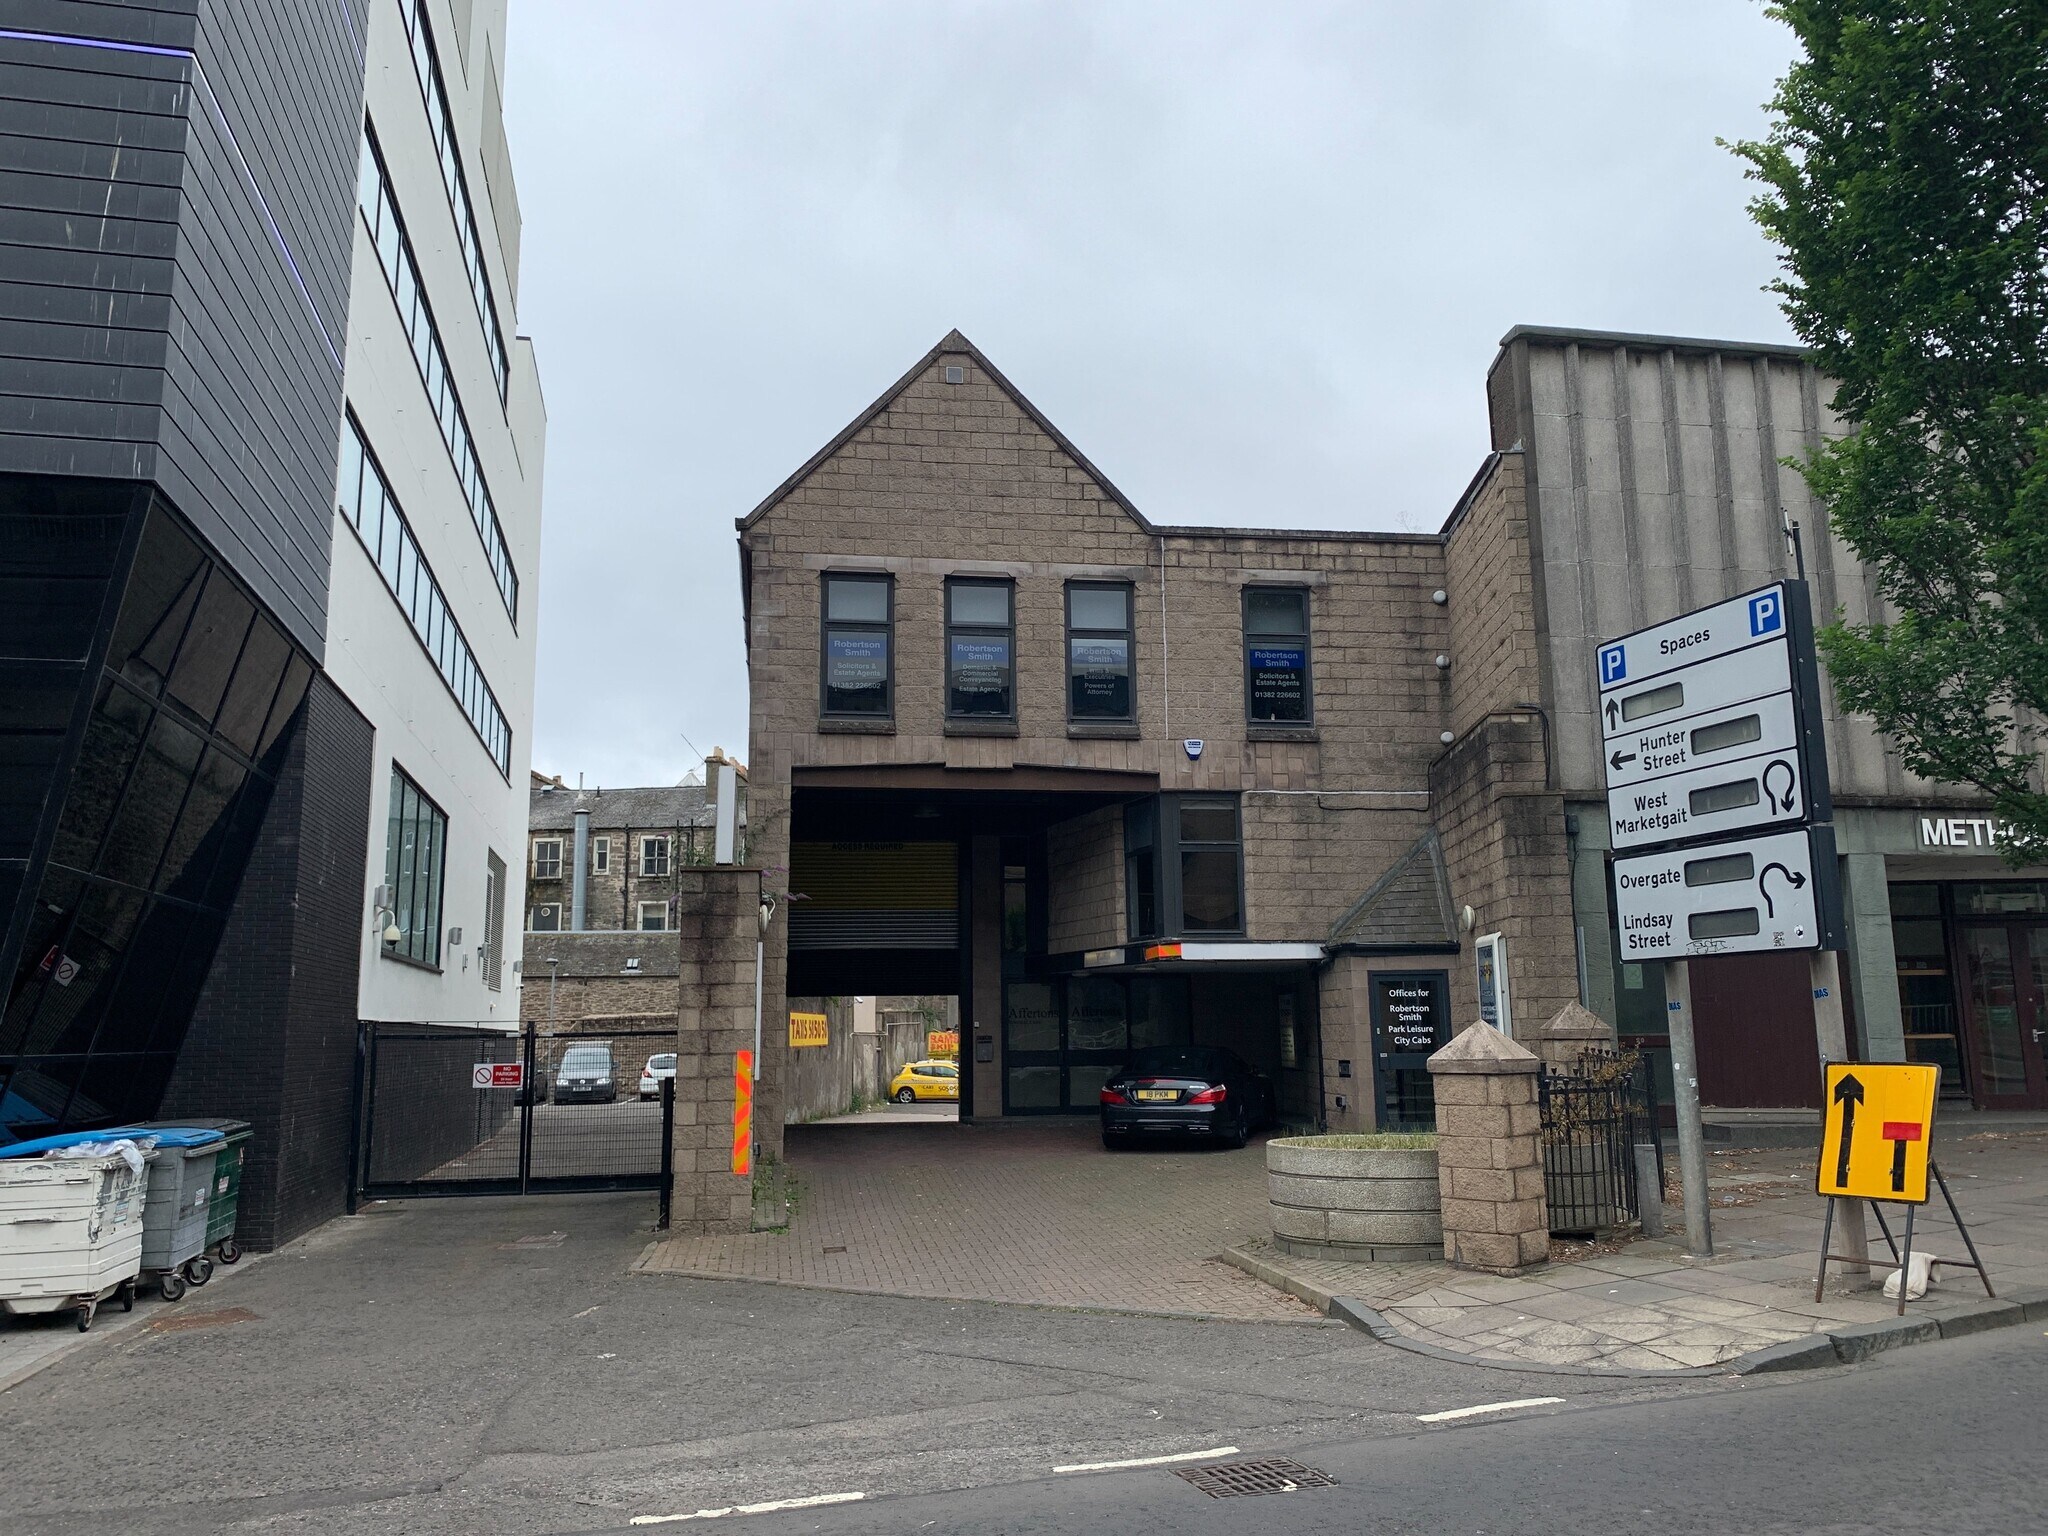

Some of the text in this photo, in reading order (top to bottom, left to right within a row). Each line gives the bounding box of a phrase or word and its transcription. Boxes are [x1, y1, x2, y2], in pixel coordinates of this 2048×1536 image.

[833, 640, 881, 649] Robertson
[1660, 629, 1710, 656] Spaces
[845, 648, 871, 656] Smith
[957, 644, 1003, 653] Robertson
[1077, 647, 1122, 655] Robertson
[968, 652, 993, 660] Smith
[1087, 655, 1113, 663] Smith
[1254, 651, 1299, 659] Robertson
[1265, 659, 1290, 667] Smith
[856, 669, 881, 678] Agents
[958, 676, 1002, 684] Conveyancing
[1639, 730, 1687, 752] Hunter
[1643, 749, 1687, 771] Street
[1634, 791, 1668, 812] West
[1615, 808, 1688, 835] Marketgait
[1620, 868, 1681, 889] Overgate
[1623, 913, 1673, 930] Lindsay
[1629, 932, 1671, 949] Street
[1388, 989, 1430, 997] Offices for
[1389, 1005, 1430, 1013] Robertson
[1398, 1013, 1422, 1021] Smith
[1388, 1025, 1434, 1033] Park Leisure
[1394, 1036, 1432, 1046] City Cabs
